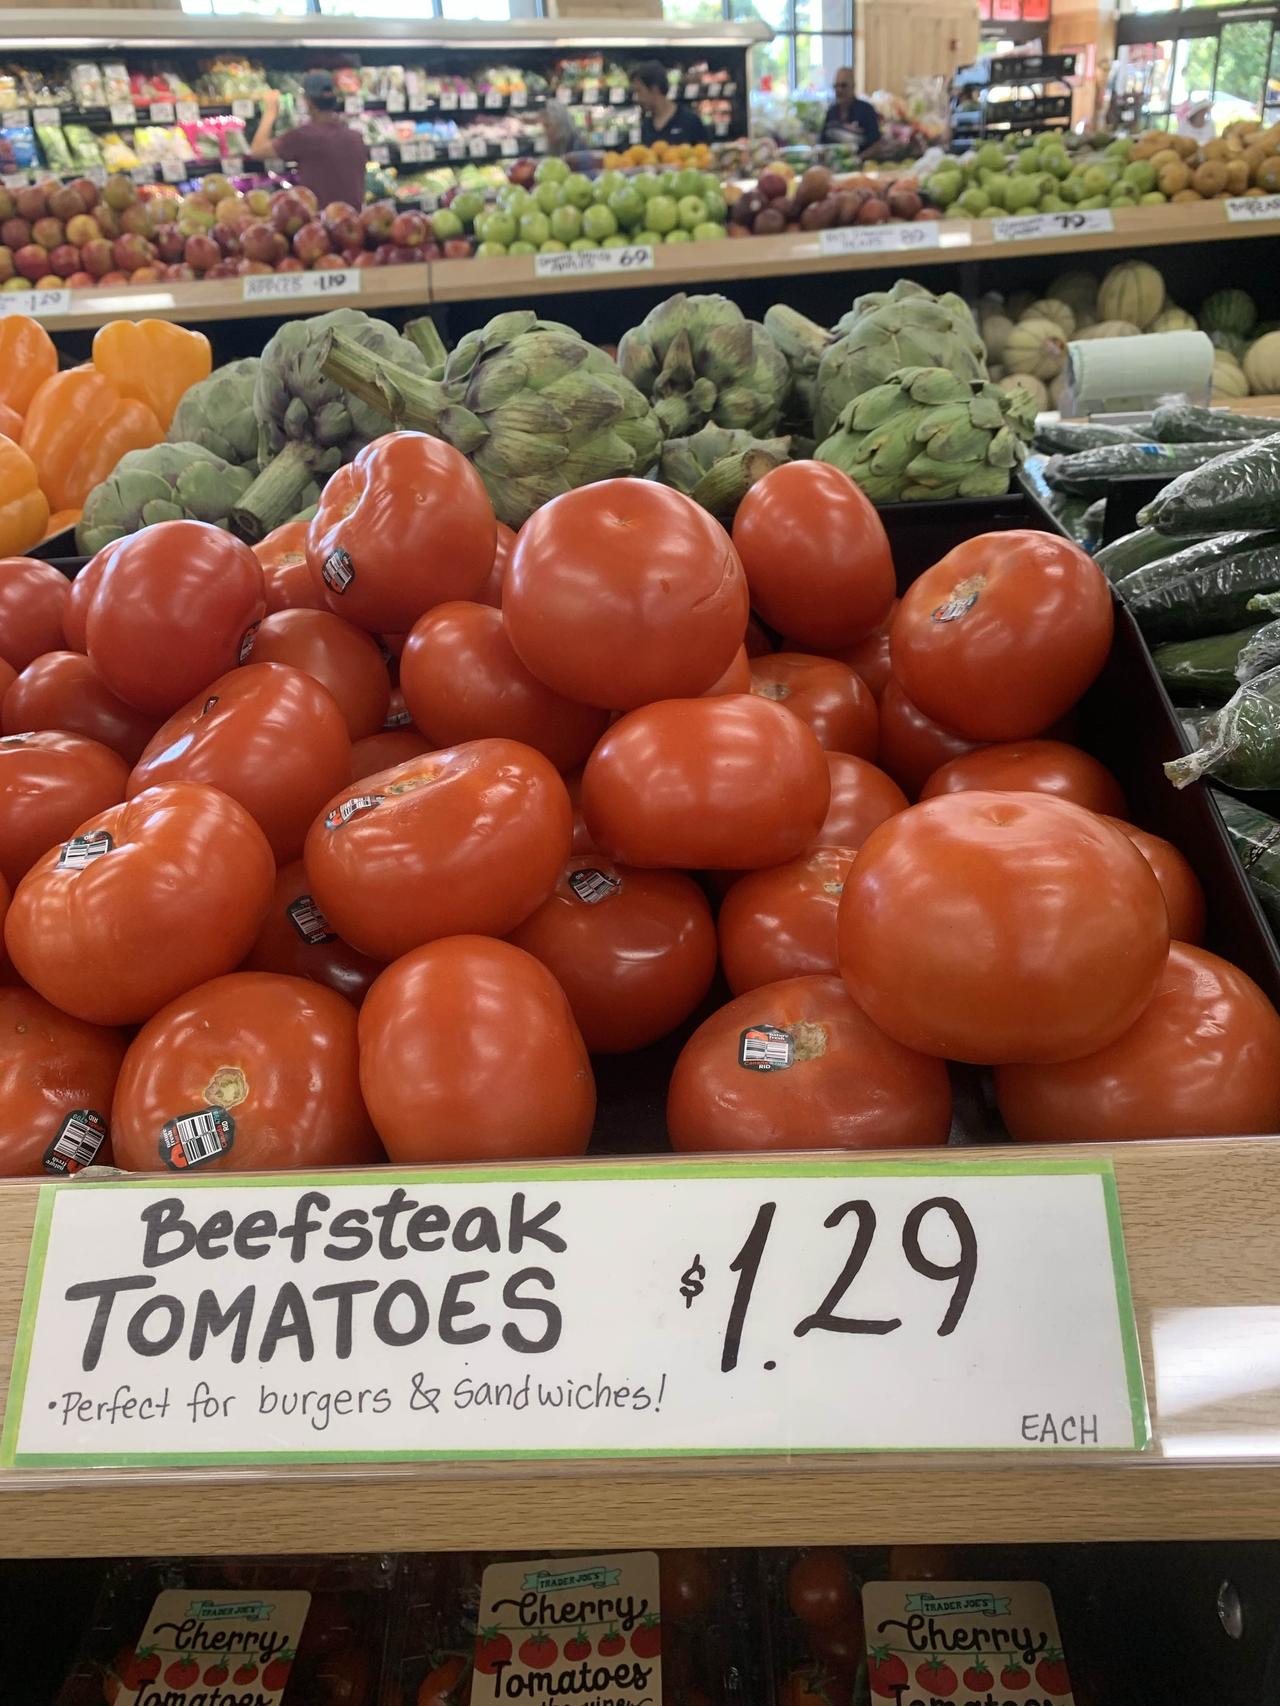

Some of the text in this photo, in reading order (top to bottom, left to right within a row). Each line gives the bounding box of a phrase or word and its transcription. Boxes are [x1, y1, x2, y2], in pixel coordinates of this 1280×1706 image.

[140, 1187, 568, 1269] Beefsteak
[65, 1266, 564, 1373] TOMATOES
[60, 1386, 172, 1425] Perfect
[186, 1382, 237, 1424] for
[258, 1385, 393, 1432] burgers
[409, 1371, 441, 1415] &
[1020, 1413, 1099, 1445] EACH
[540, 1576, 575, 1589] TRADER
[491, 1592, 648, 1631] Cherry
[925, 1601, 962, 1611] TRADER
[153, 1618, 289, 1664] Cherry
[877, 1614, 1047, 1665] Cherry
[491, 1660, 652, 1699] Tomatoes
